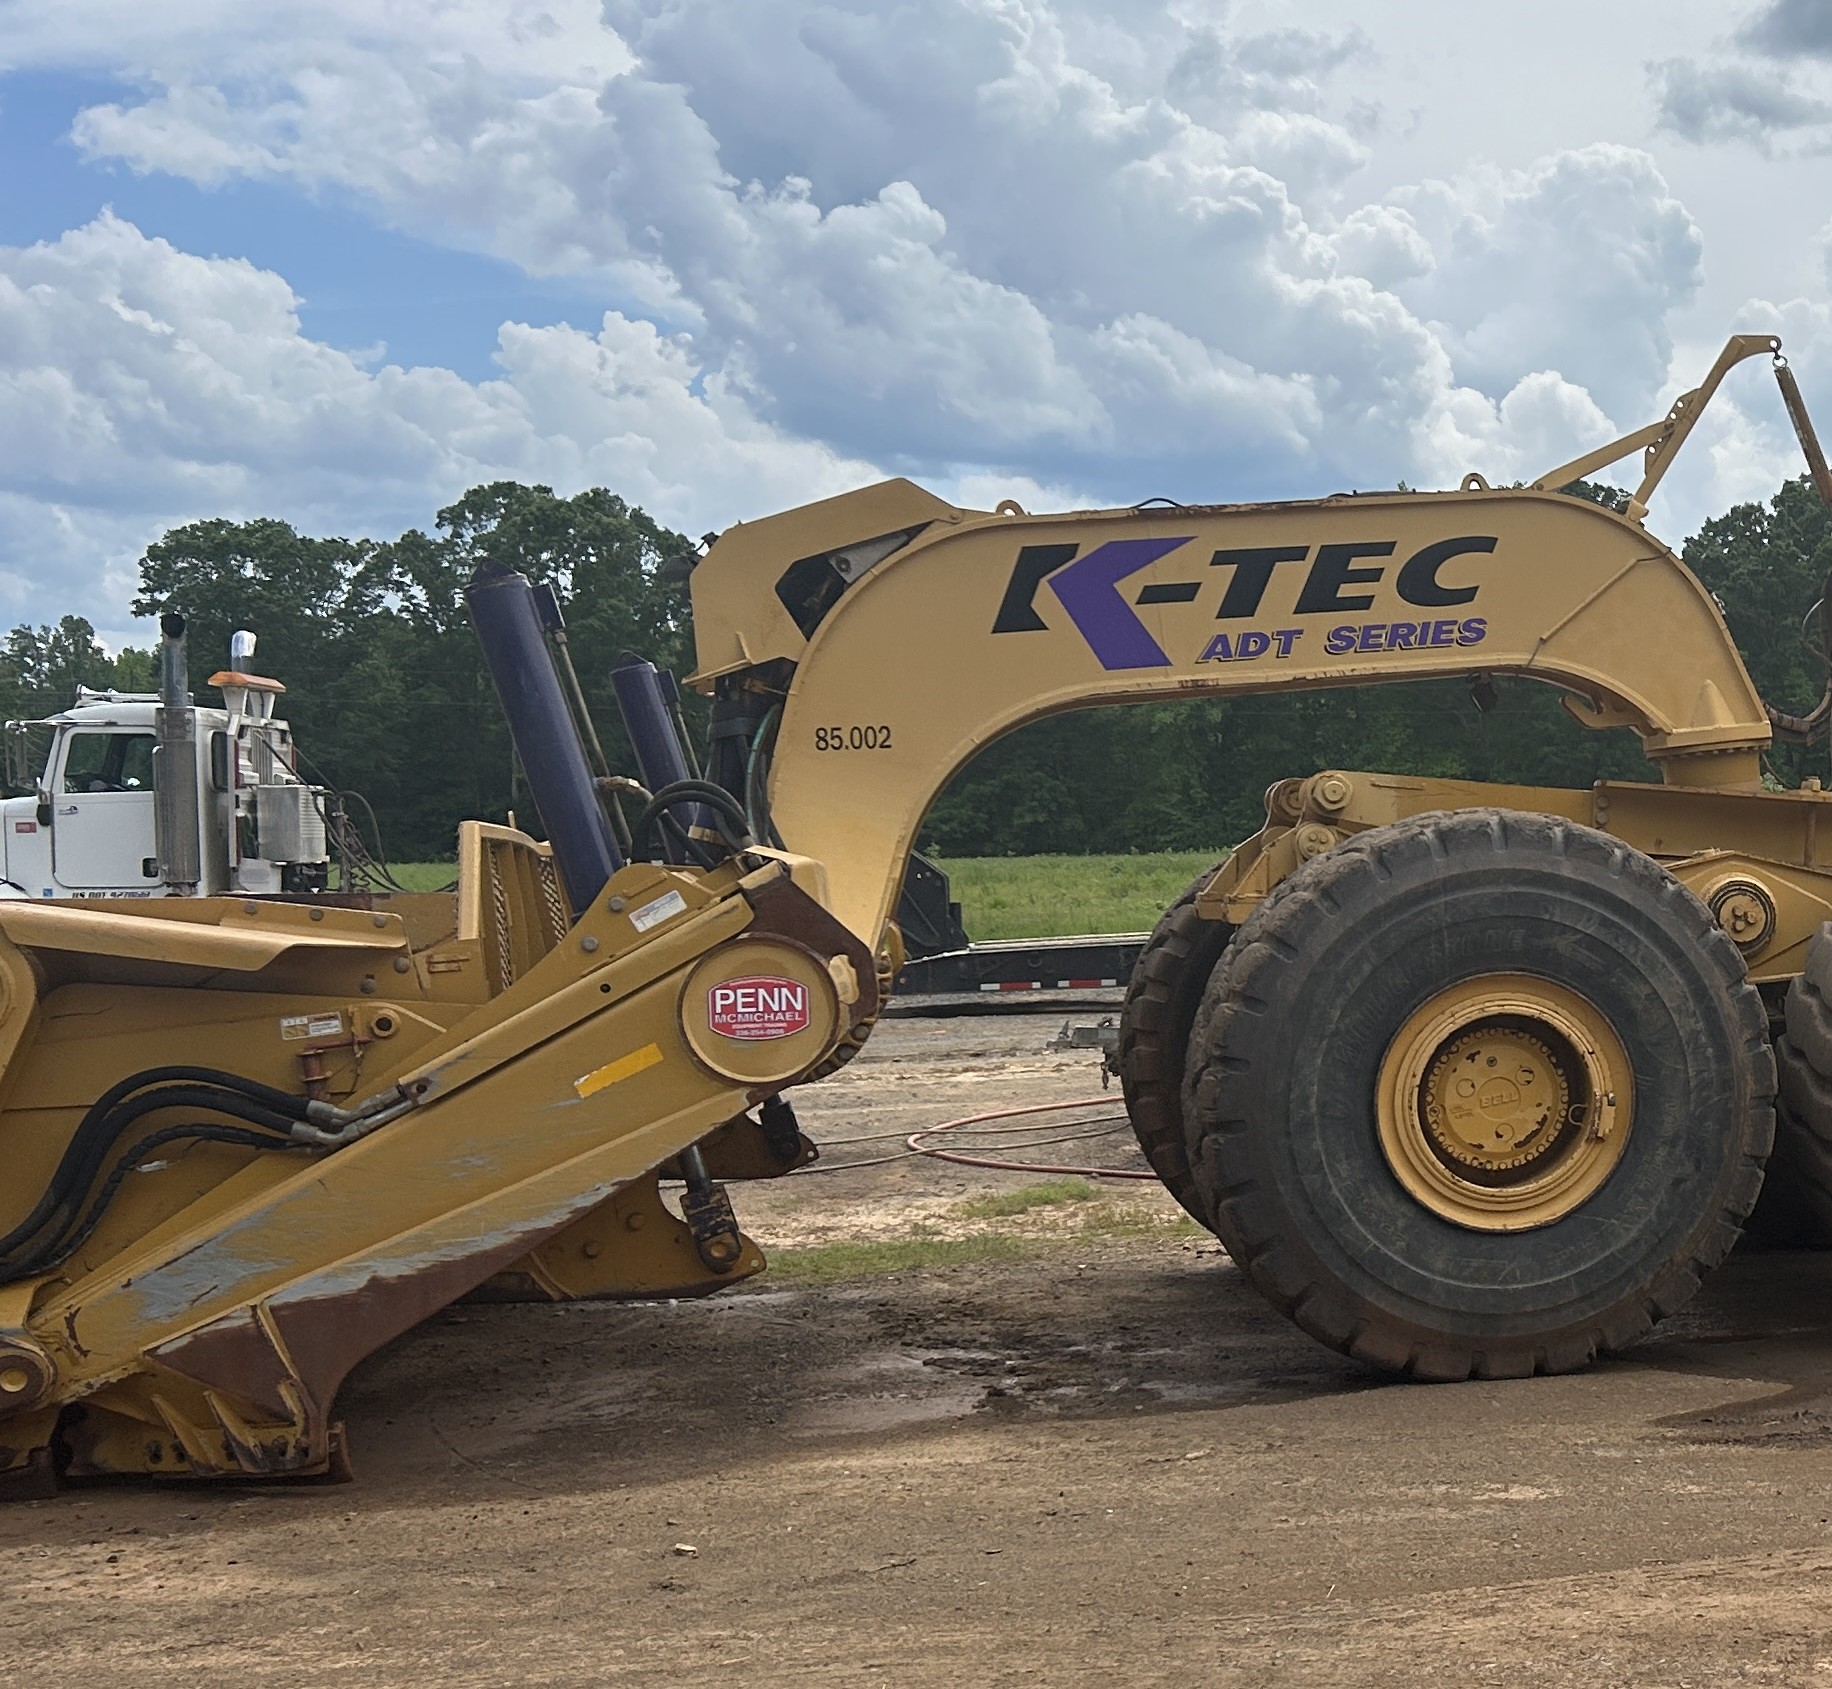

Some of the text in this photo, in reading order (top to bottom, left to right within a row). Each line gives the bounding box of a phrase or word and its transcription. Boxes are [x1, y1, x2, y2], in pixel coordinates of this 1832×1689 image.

[991, 536, 1498, 671] K-TEC
[1195, 617, 1488, 664] ADT SERIES
[815, 726, 892, 751] 85.002
[714, 986, 803, 1013] PENN
[714, 1011, 804, 1024] MCMICHAEL
